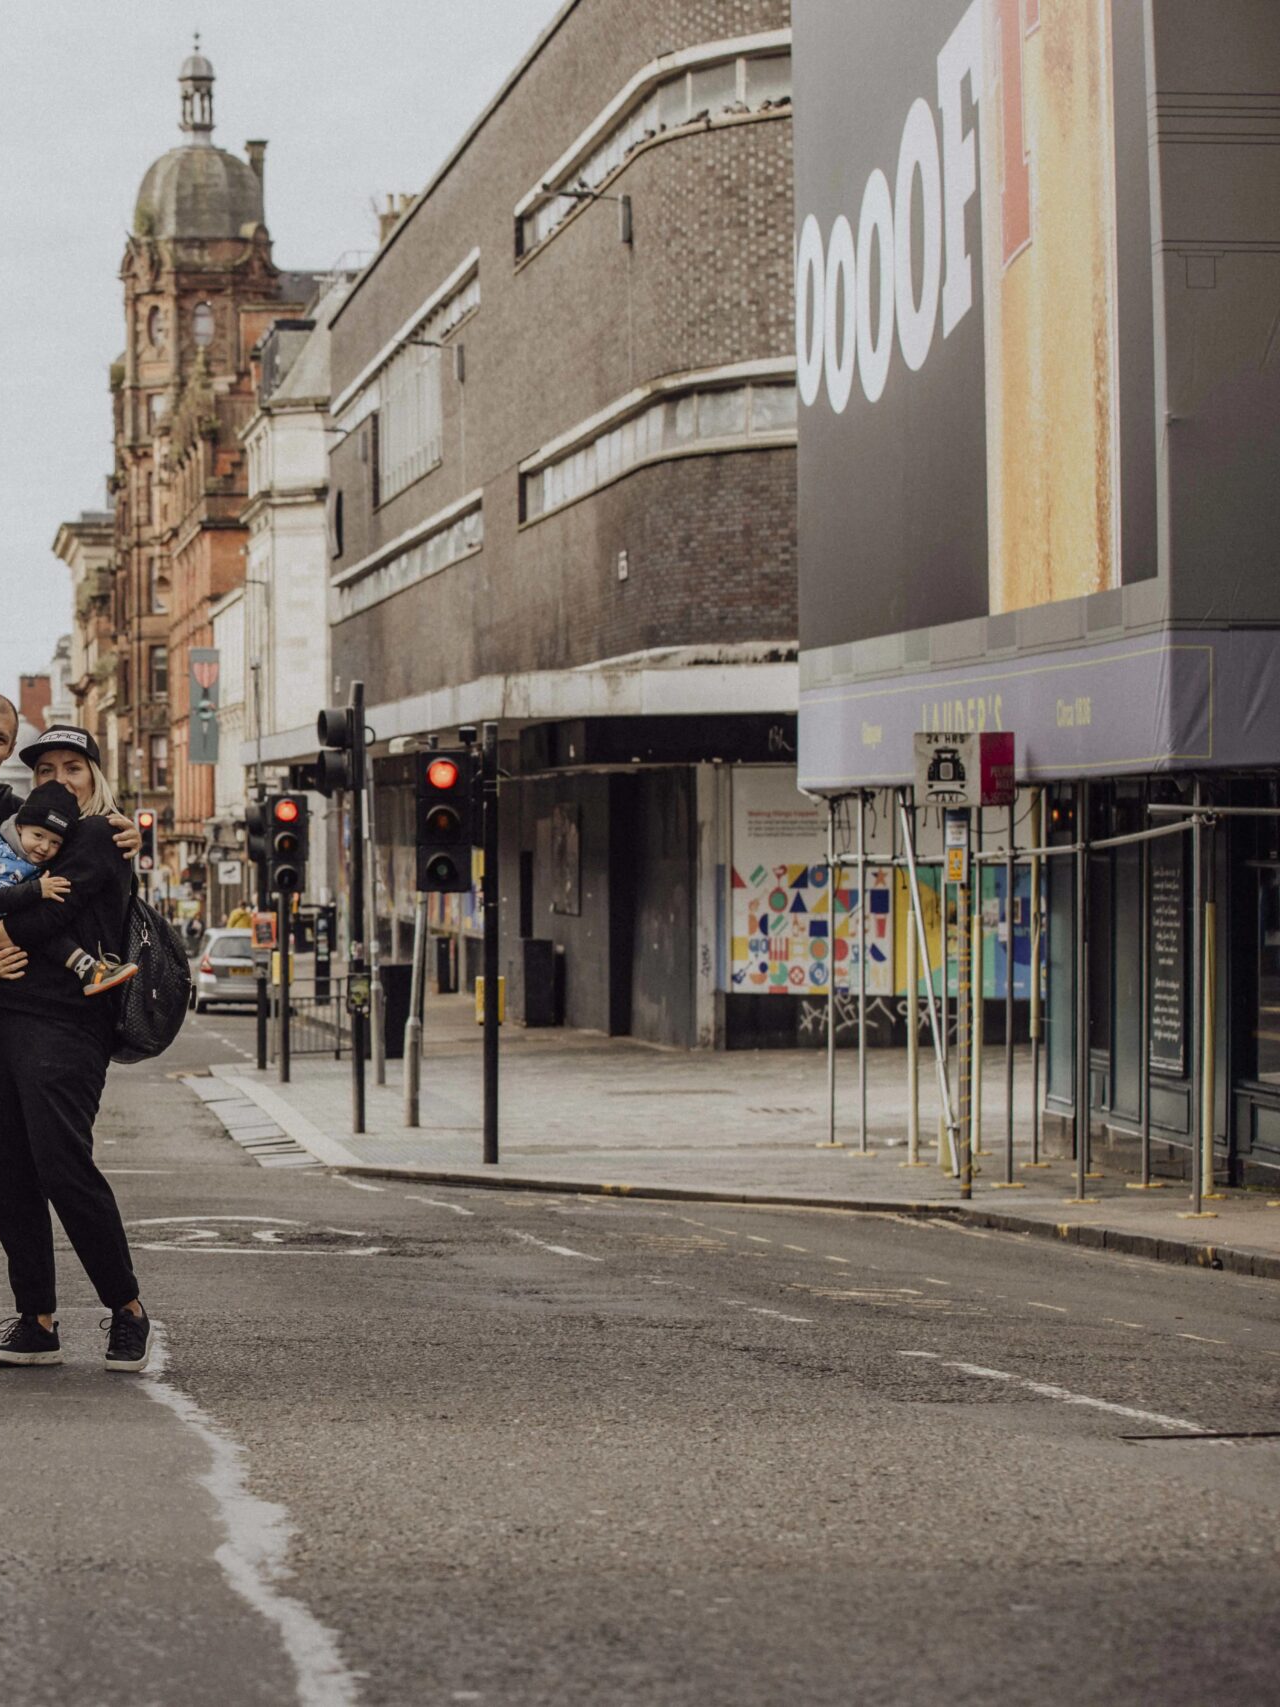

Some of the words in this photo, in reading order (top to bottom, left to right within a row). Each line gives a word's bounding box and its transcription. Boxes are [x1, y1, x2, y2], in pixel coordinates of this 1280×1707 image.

[926, 734, 939, 744] 24
[945, 734, 966, 744] HRS
[935, 794, 959, 803] TAXI
